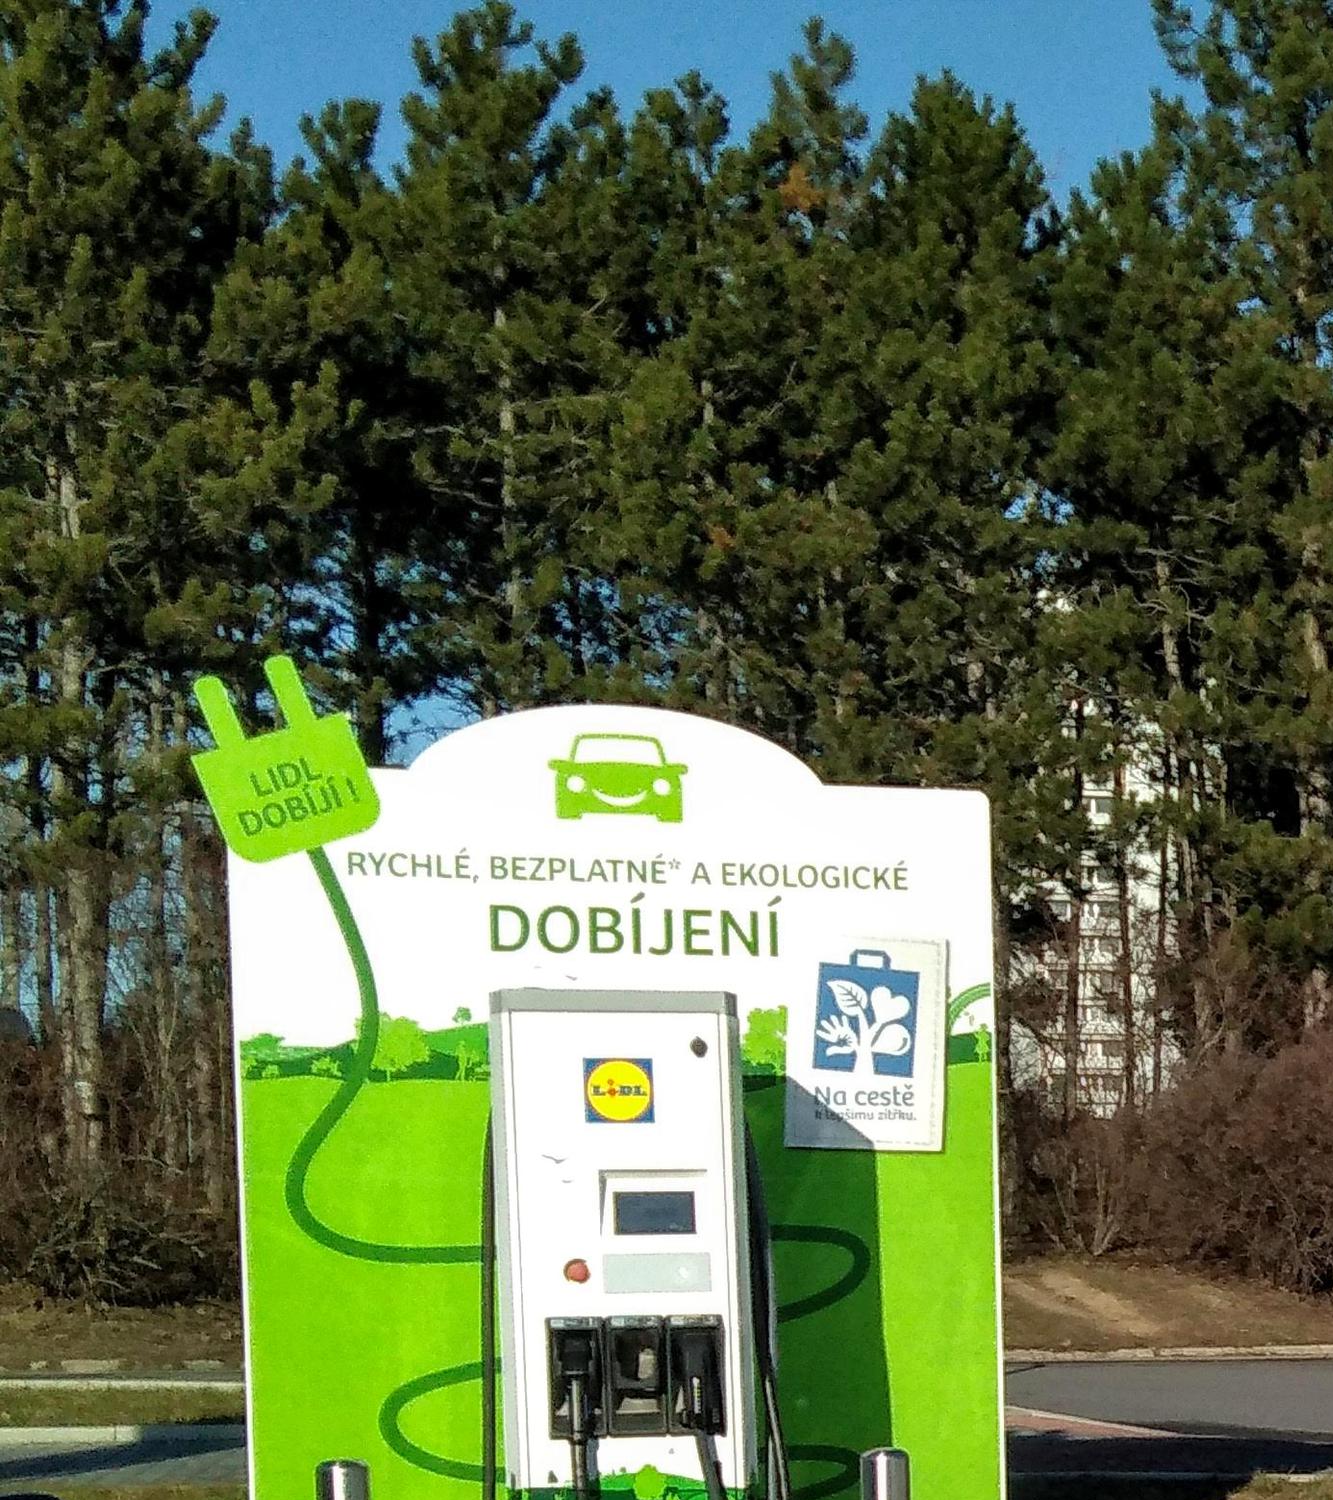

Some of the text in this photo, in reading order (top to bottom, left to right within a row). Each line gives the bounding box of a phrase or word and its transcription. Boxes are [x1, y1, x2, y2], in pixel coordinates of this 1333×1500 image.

[250, 757, 322, 797] LIDL
[346, 847, 480, 884] RYCHLÉ,
[690, 861, 712, 885] A
[720, 860, 910, 891] EKOLOGICKÉ
[488, 891, 783, 958] DOBÍJENÍ
[814, 1084, 915, 1107] Na cestě
